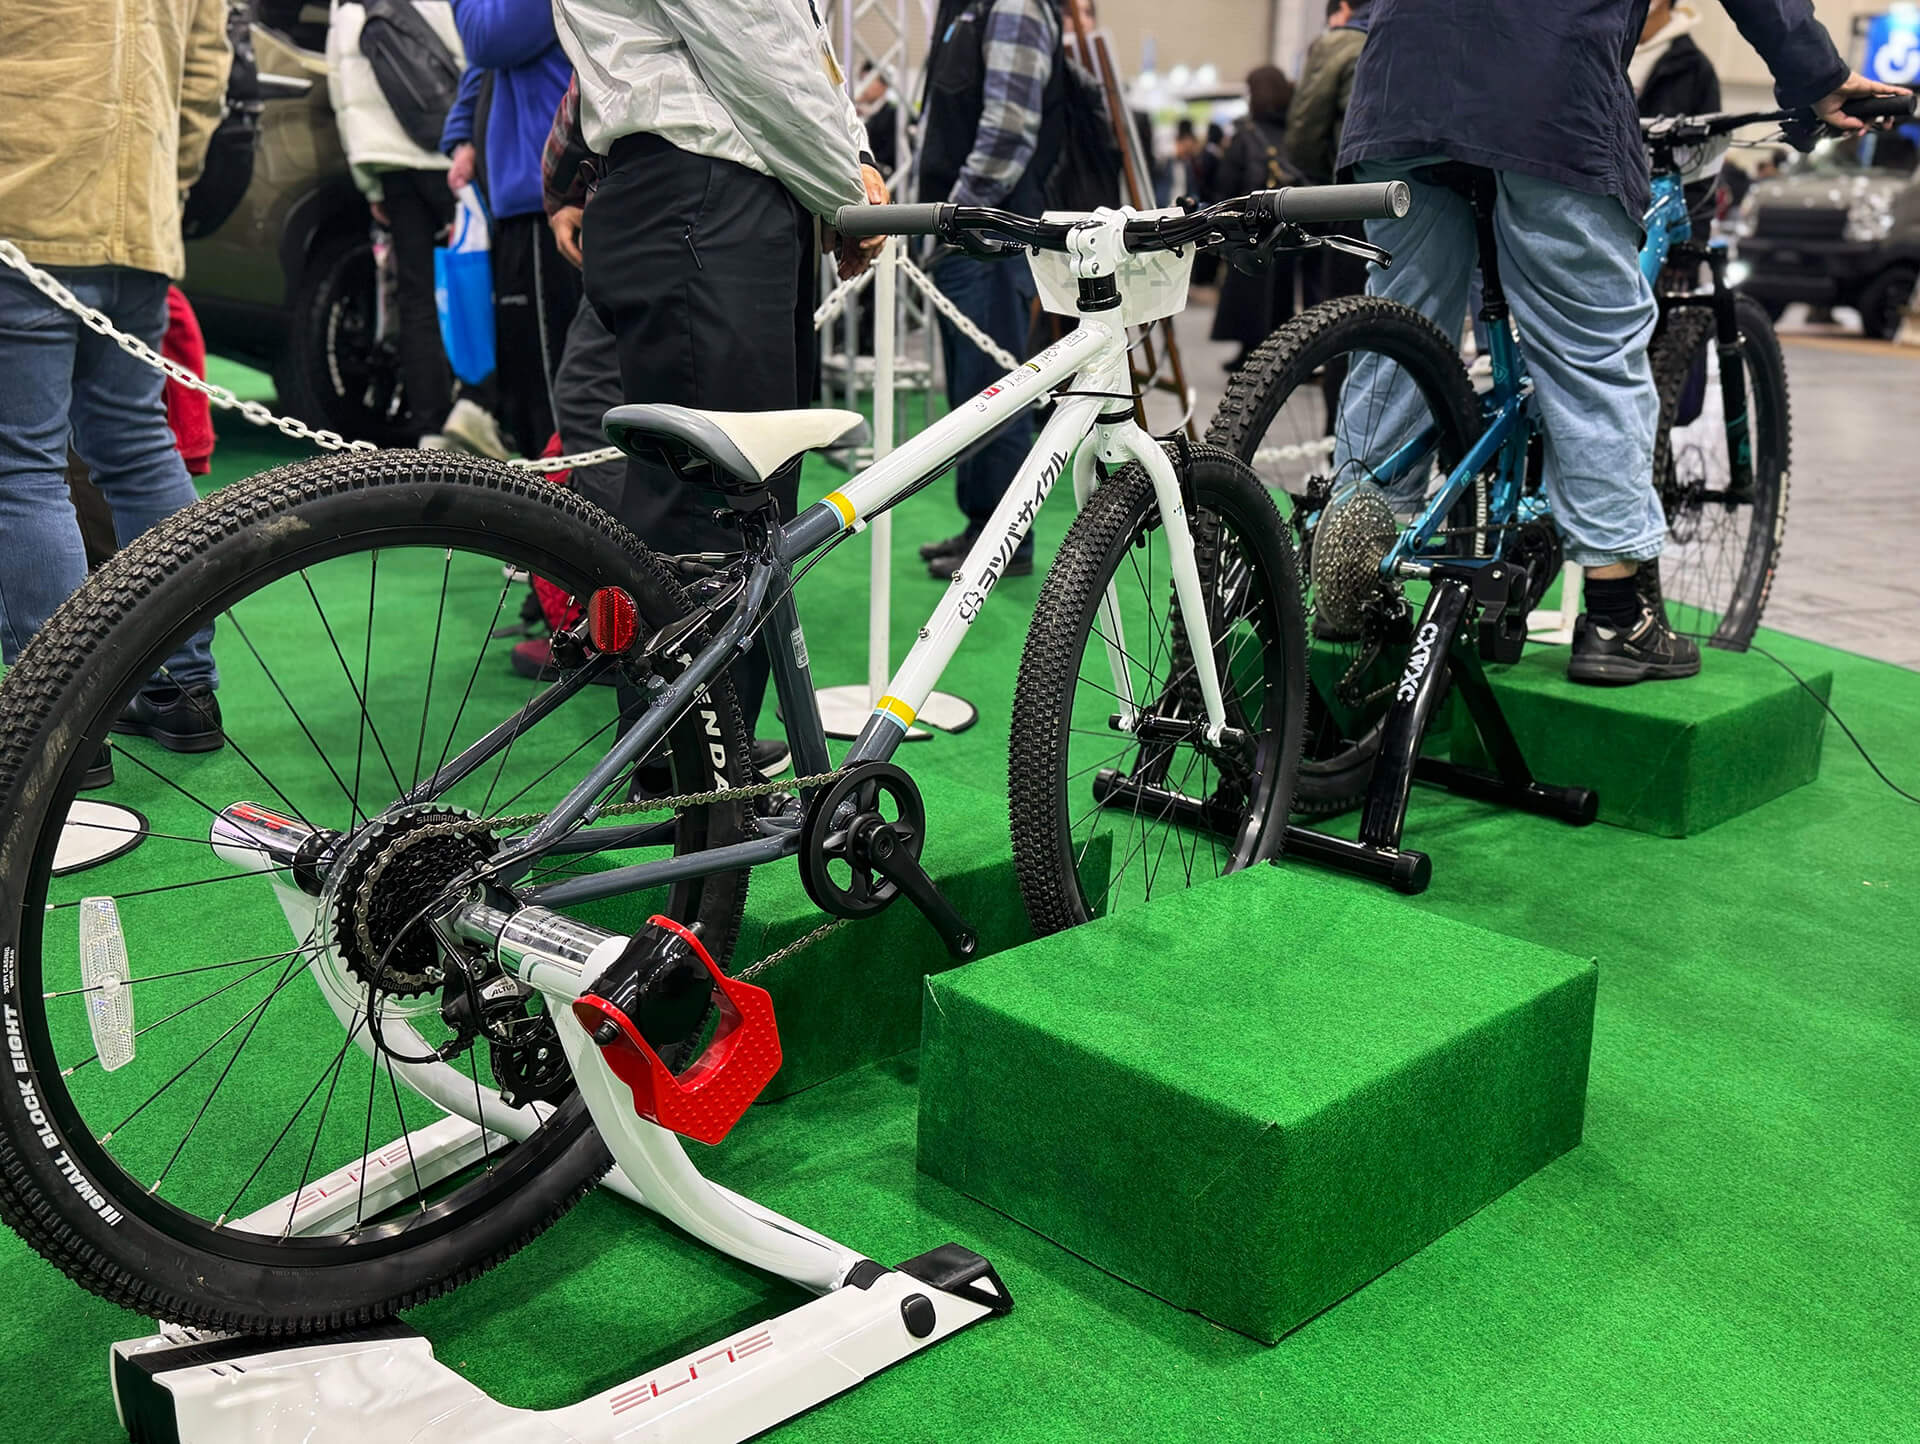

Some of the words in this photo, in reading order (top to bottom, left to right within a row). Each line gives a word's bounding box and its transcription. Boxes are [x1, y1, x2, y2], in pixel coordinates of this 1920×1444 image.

[978, 451, 1069, 595] ヨツバサイクル
[1397, 623, 1439, 702] CXWXC
[491, 983, 516, 997] ALTUS
[4, 1004, 29, 1073] EIGHT
[17, 1079, 60, 1149] BLOCK
[54, 1150, 107, 1210] SMALL
[610, 1329, 774, 1415] ELITE
